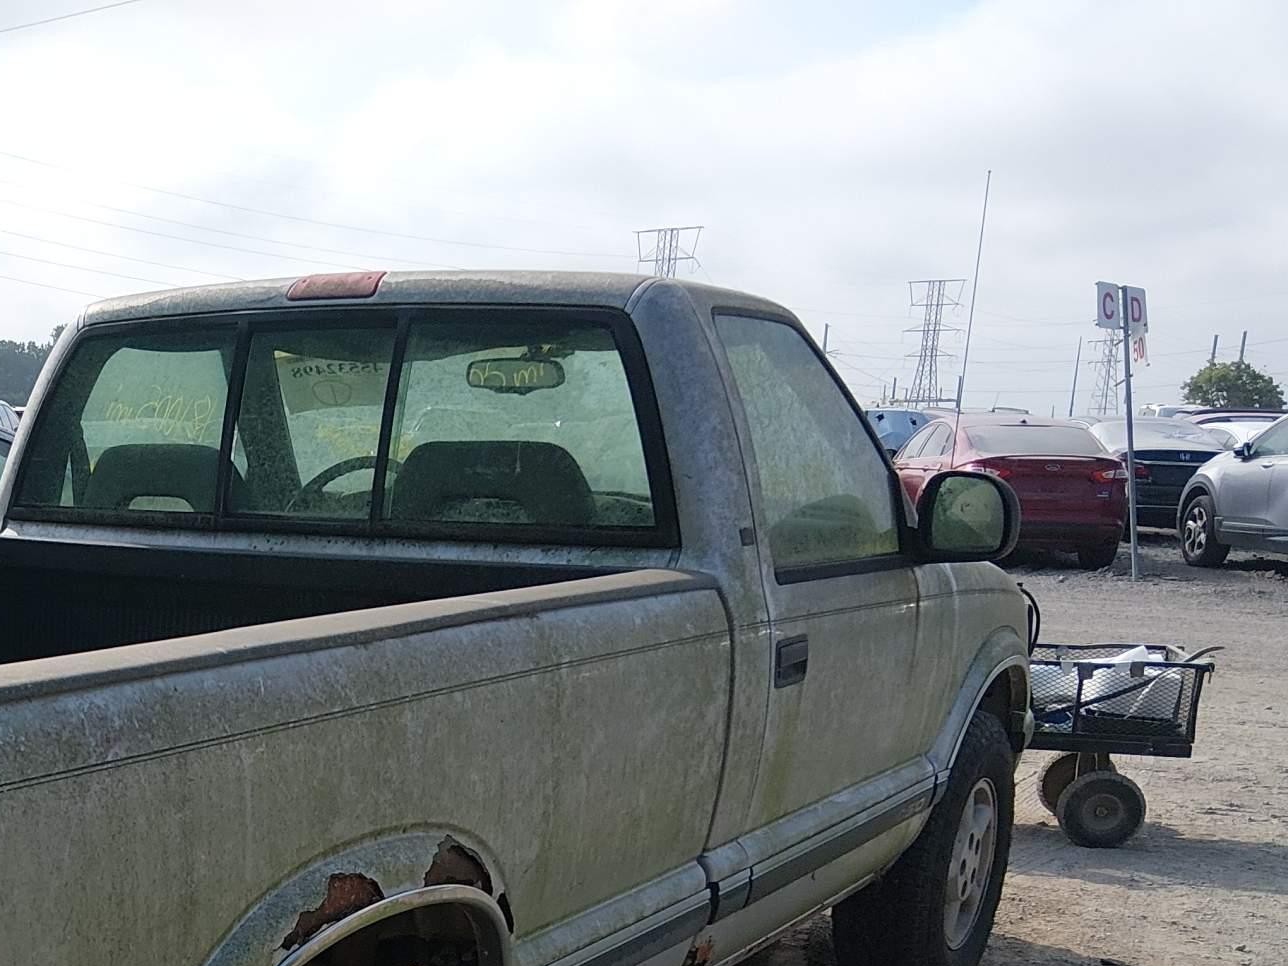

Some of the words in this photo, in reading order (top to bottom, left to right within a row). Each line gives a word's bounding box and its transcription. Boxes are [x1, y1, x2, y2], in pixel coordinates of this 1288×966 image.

[1102, 292, 1115, 320] C
[1130, 296, 1142, 322] D
[1133, 336, 1145, 362] 50
